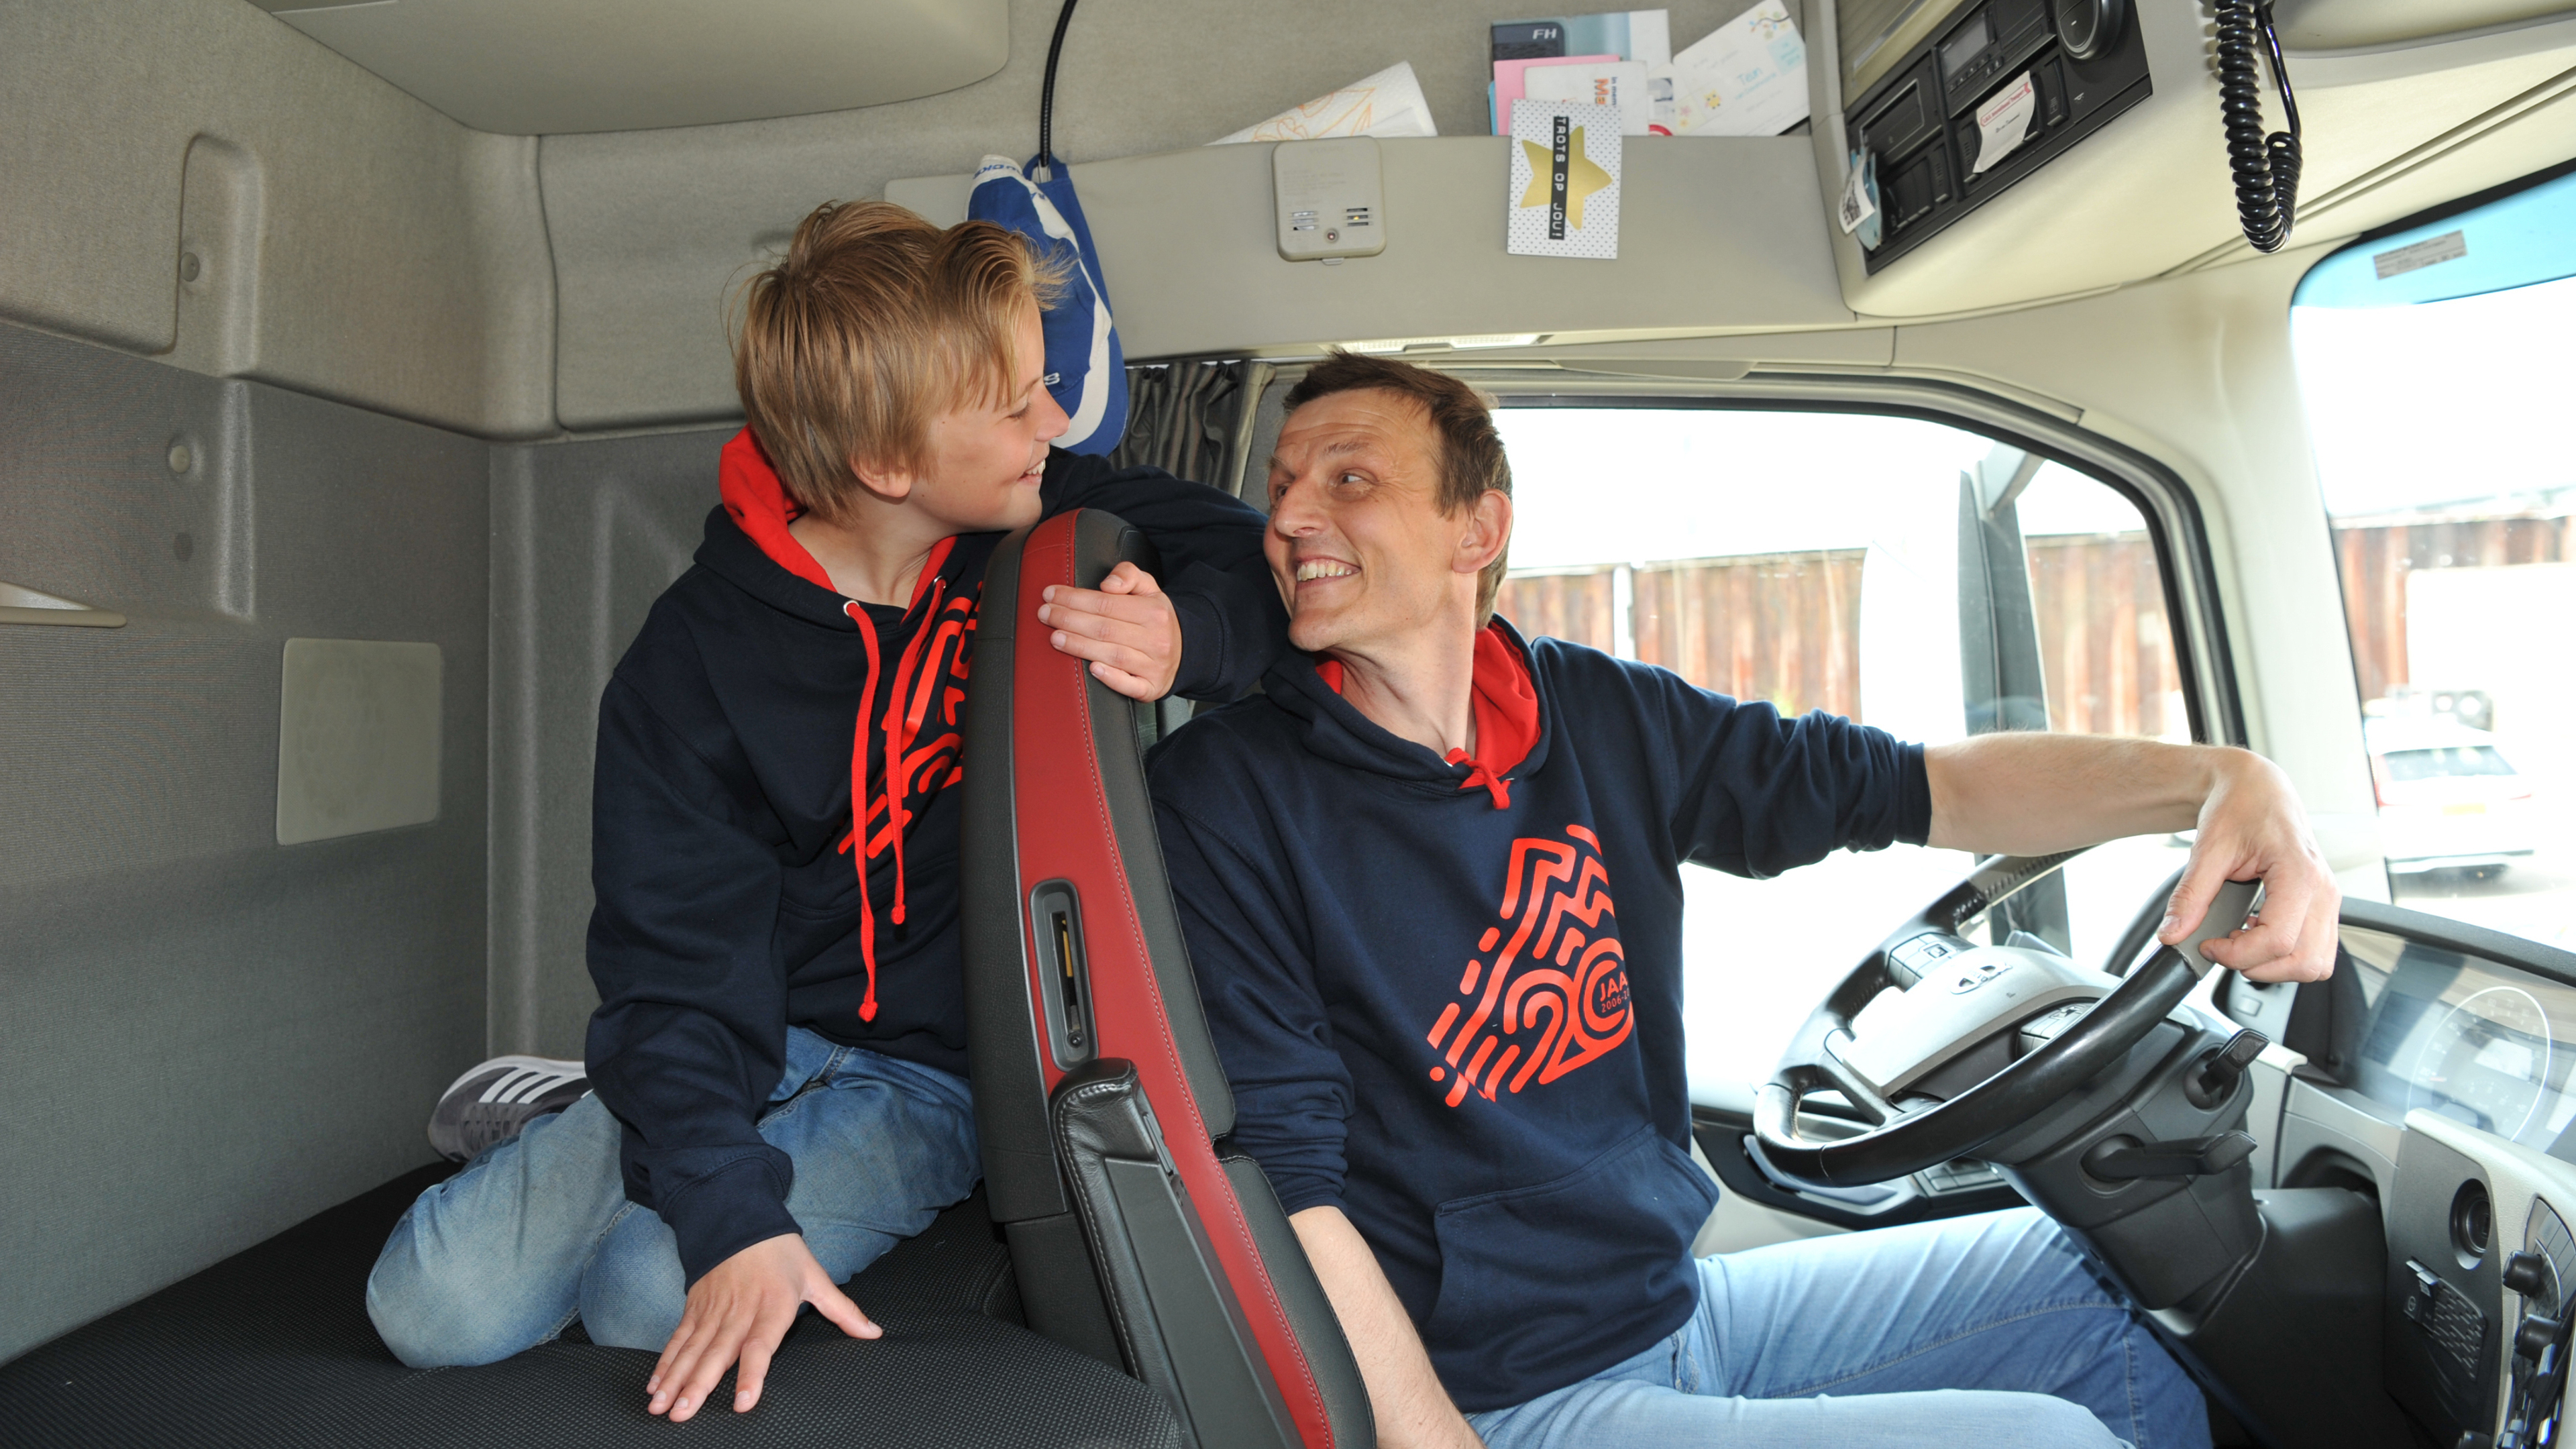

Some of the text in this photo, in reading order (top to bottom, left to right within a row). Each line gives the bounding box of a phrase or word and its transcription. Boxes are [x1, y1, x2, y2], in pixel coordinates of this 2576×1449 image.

[1532, 28, 1557, 40] FH
[1552, 118, 1566, 237] TROTS OP JOU!
